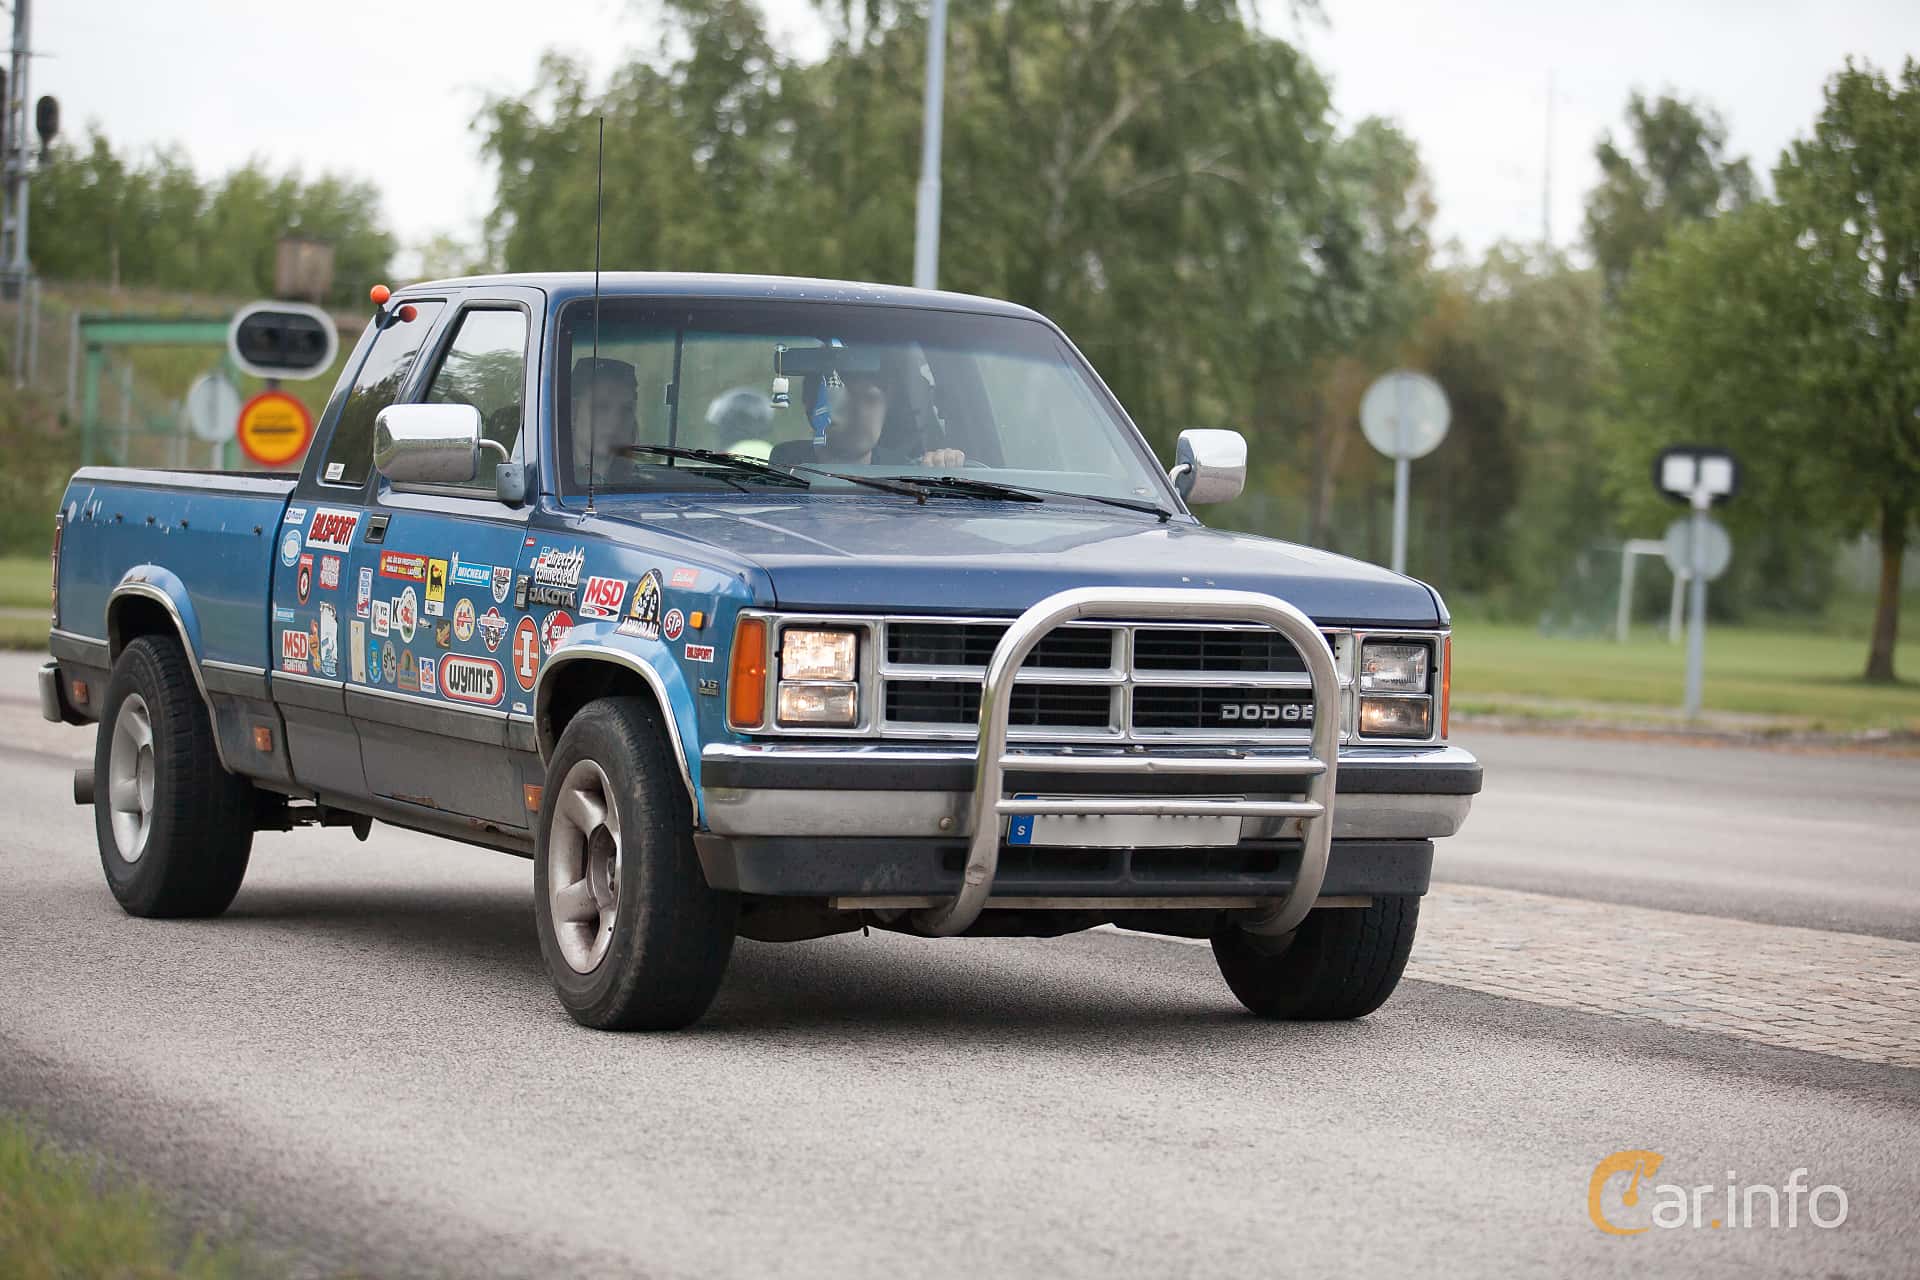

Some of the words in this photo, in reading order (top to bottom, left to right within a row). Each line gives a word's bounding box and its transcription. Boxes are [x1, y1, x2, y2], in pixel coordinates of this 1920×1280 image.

[309, 513, 357, 546] BILSPORT
[457, 567, 490, 580] MICHELIN
[529, 587, 577, 609] DAKOTA
[584, 578, 625, 606] MSD
[667, 614, 681, 634] STP
[284, 632, 307, 658] MSD
[686, 646, 713, 660] BILSPORT
[1221, 704, 1313, 720] DODGE
[1017, 825, 1026, 836] S
